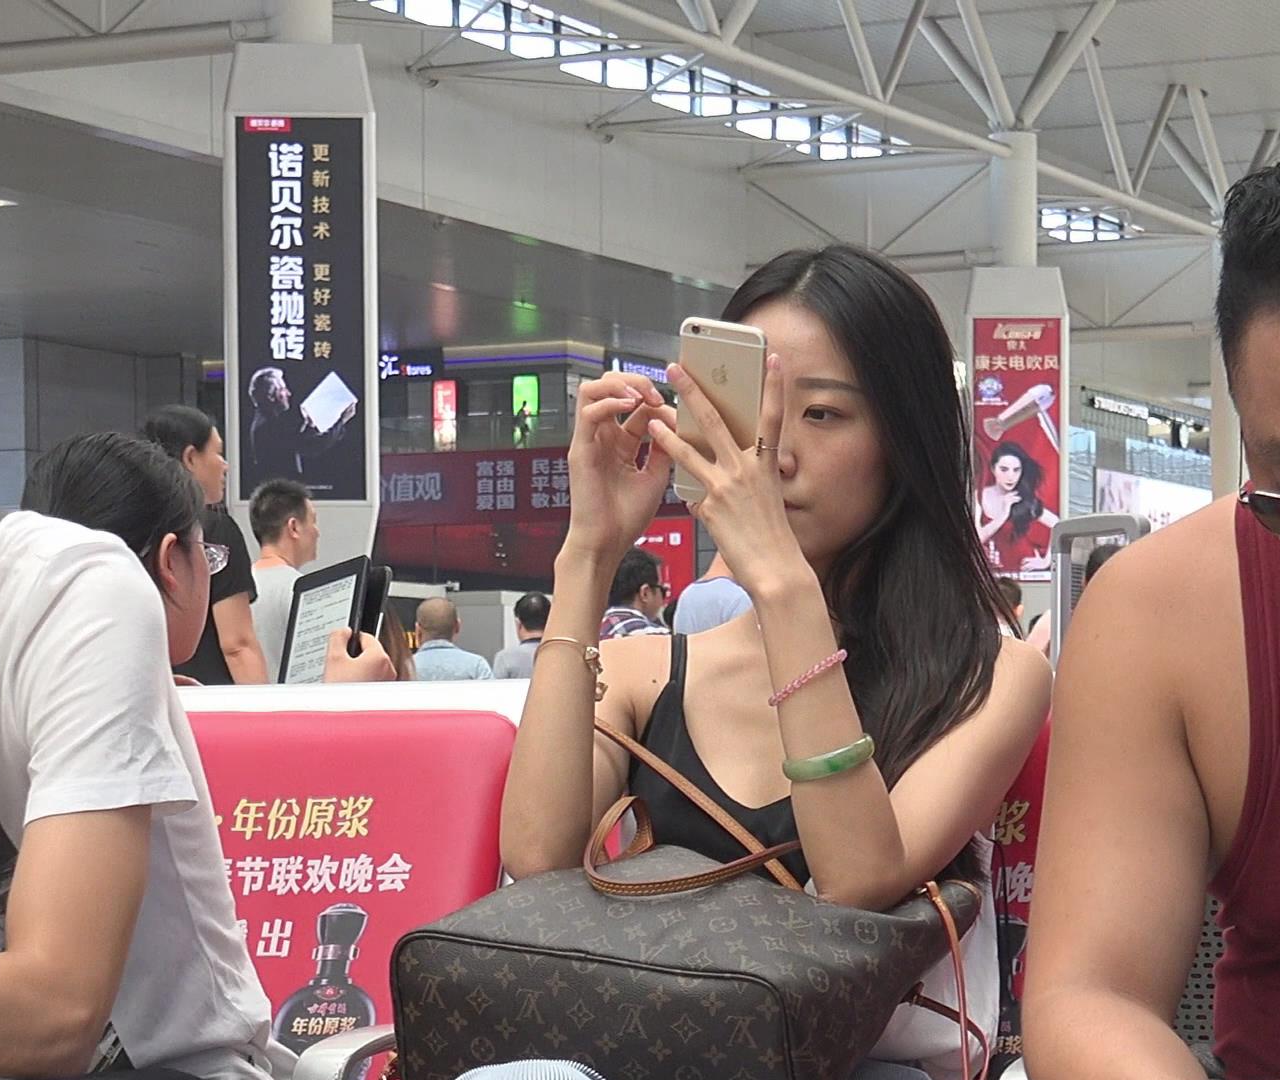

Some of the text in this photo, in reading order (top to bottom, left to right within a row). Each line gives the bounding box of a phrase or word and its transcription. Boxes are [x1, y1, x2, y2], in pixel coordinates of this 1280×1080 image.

[476, 460, 515, 477] 富强
[476, 478, 515, 493] 自由
[476, 494, 515, 511] 爱国
[224, 853, 413, 897] 节联欢晚会
